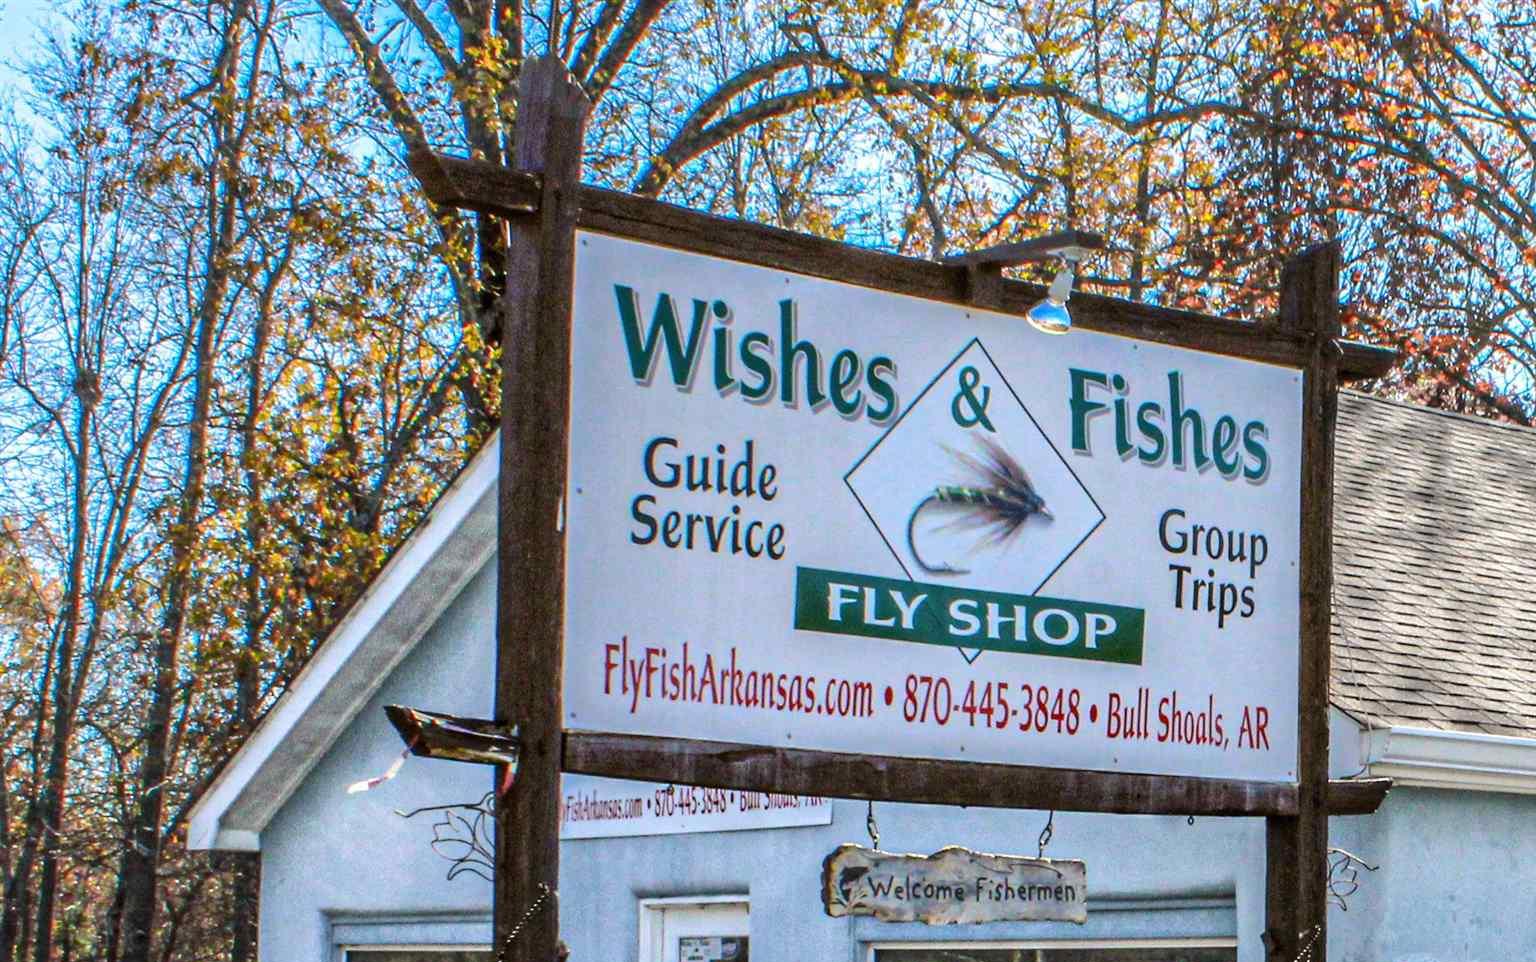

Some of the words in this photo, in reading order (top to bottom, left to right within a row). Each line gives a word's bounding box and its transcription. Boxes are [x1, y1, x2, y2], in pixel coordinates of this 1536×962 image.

[614, 283, 897, 424] Wishes
[951, 365, 996, 433] &
[1068, 367, 1271, 484] Fishes
[643, 436, 778, 501] Guide
[630, 494, 785, 560] Service
[1158, 508, 1268, 579] Group
[827, 582, 928, 630] FLY
[948, 599, 1117, 649] SHOP
[1168, 563, 1256, 629] Trips
[604, 635, 874, 717] FlyFishArkansas.com
[903, 674, 1080, 735] 870-445-3848
[1106, 687, 1150, 740] Bull
[1157, 690, 1230, 751] Shoals,
[1237, 704, 1270, 750] AR
[867, 875, 965, 901] Welcome
[975, 875, 1076, 902] Fishermen
